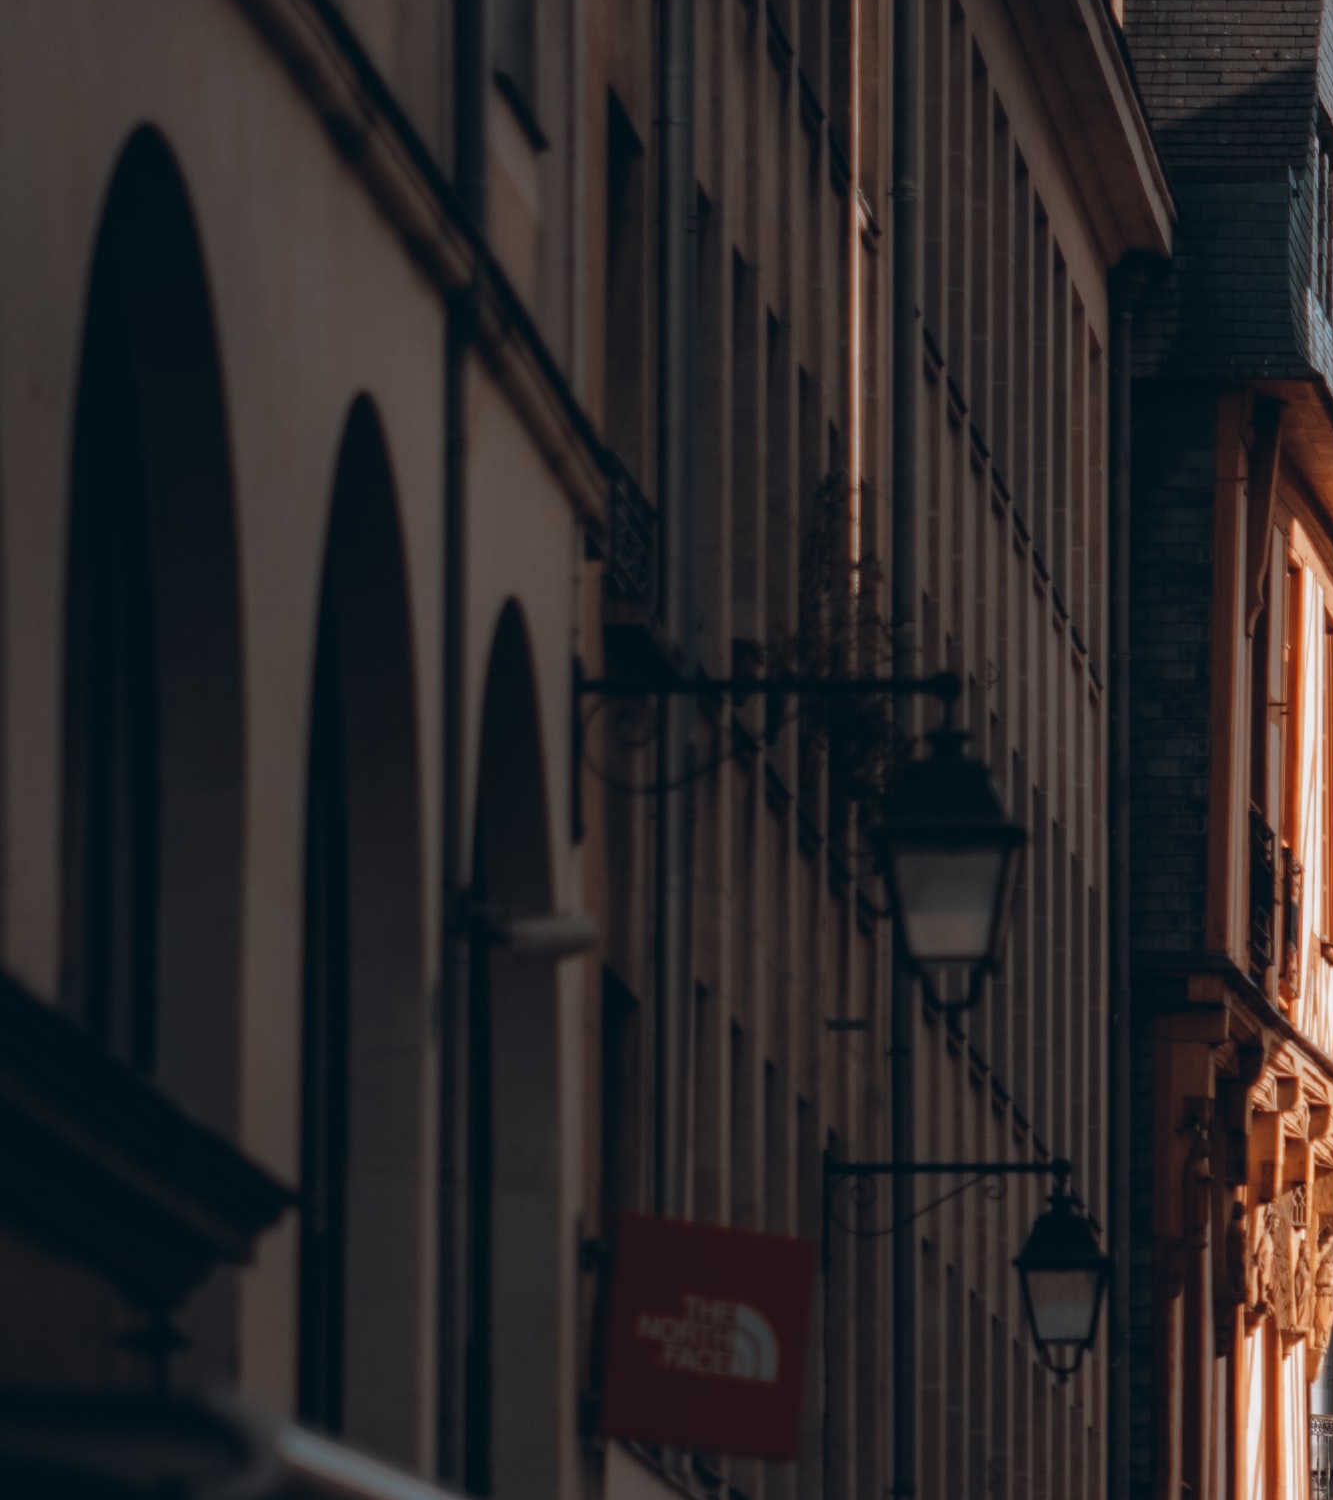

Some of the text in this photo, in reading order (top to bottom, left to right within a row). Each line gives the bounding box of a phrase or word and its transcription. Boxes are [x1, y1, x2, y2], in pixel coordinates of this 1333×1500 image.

[683, 1295, 737, 1326] THE
[637, 1315, 738, 1350] NORTH
[664, 1344, 732, 1373] FACE
